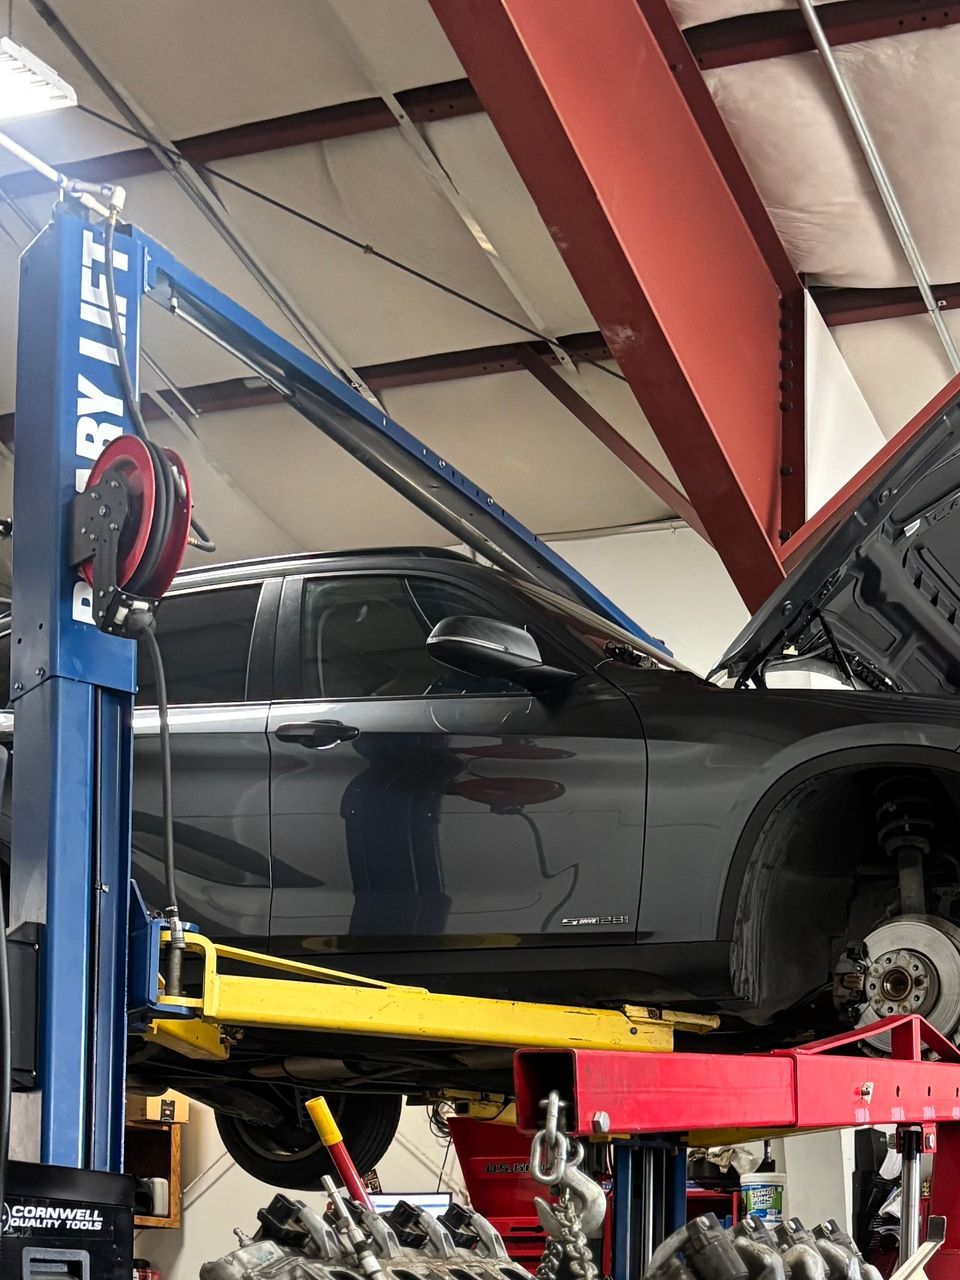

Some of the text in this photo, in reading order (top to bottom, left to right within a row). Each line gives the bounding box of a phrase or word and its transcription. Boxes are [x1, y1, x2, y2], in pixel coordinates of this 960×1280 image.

[79, 229, 129, 366] LIFT
[12, 1205, 103, 1221] CORNWELL
[11, 1217, 102, 1231] QUALITY TOOLS
